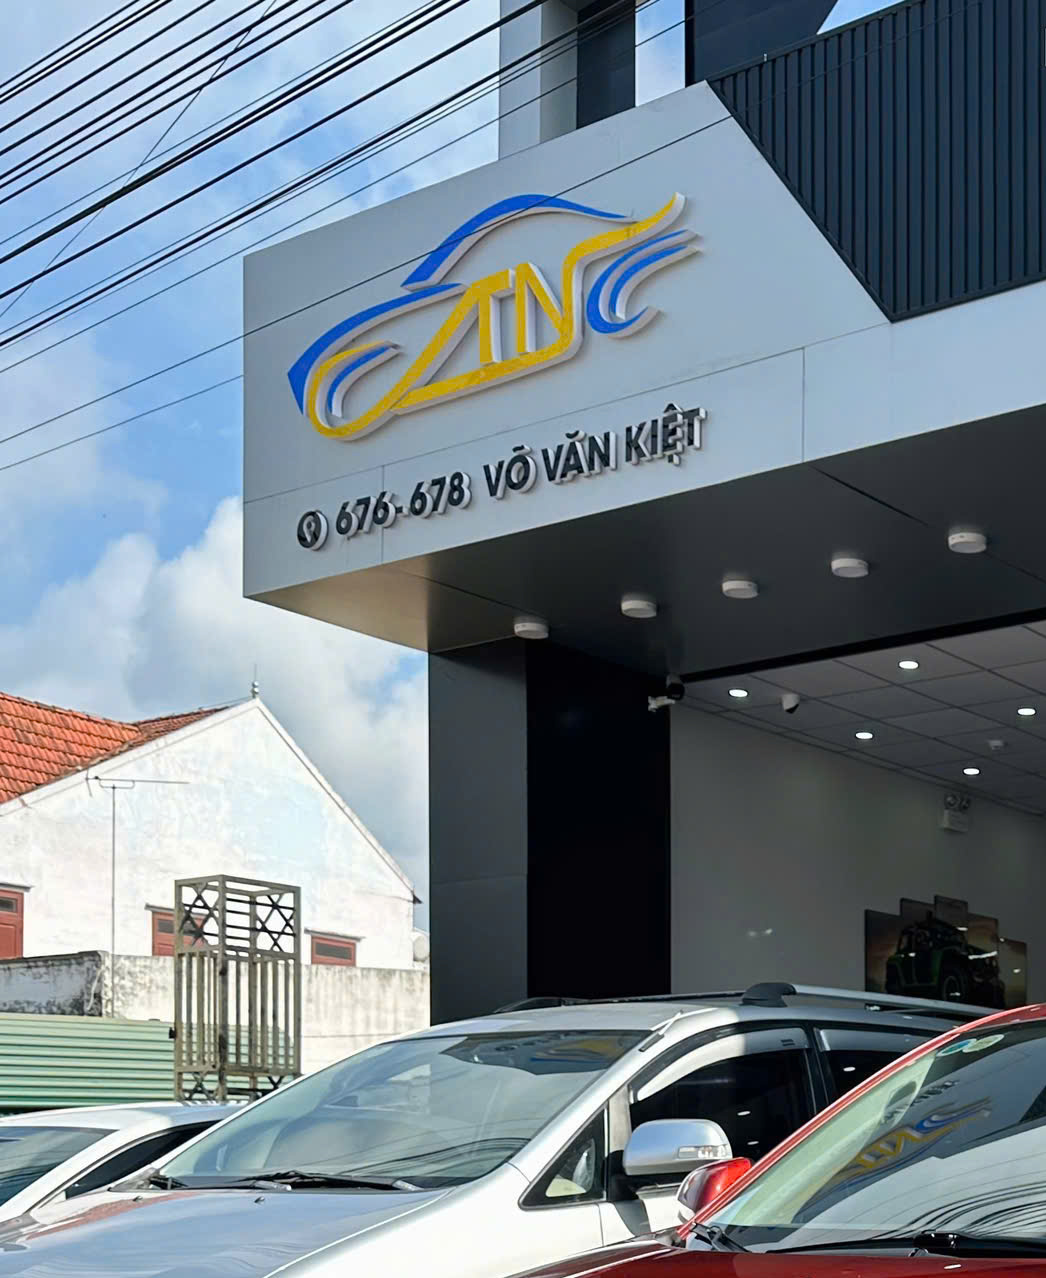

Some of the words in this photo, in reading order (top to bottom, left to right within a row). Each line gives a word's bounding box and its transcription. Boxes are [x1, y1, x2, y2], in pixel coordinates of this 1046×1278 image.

[335, 471, 472, 537] 676-678
[483, 444, 538, 499] VÕ
[541, 430, 618, 484] VĂN
[625, 403, 708, 466] KIỆT
